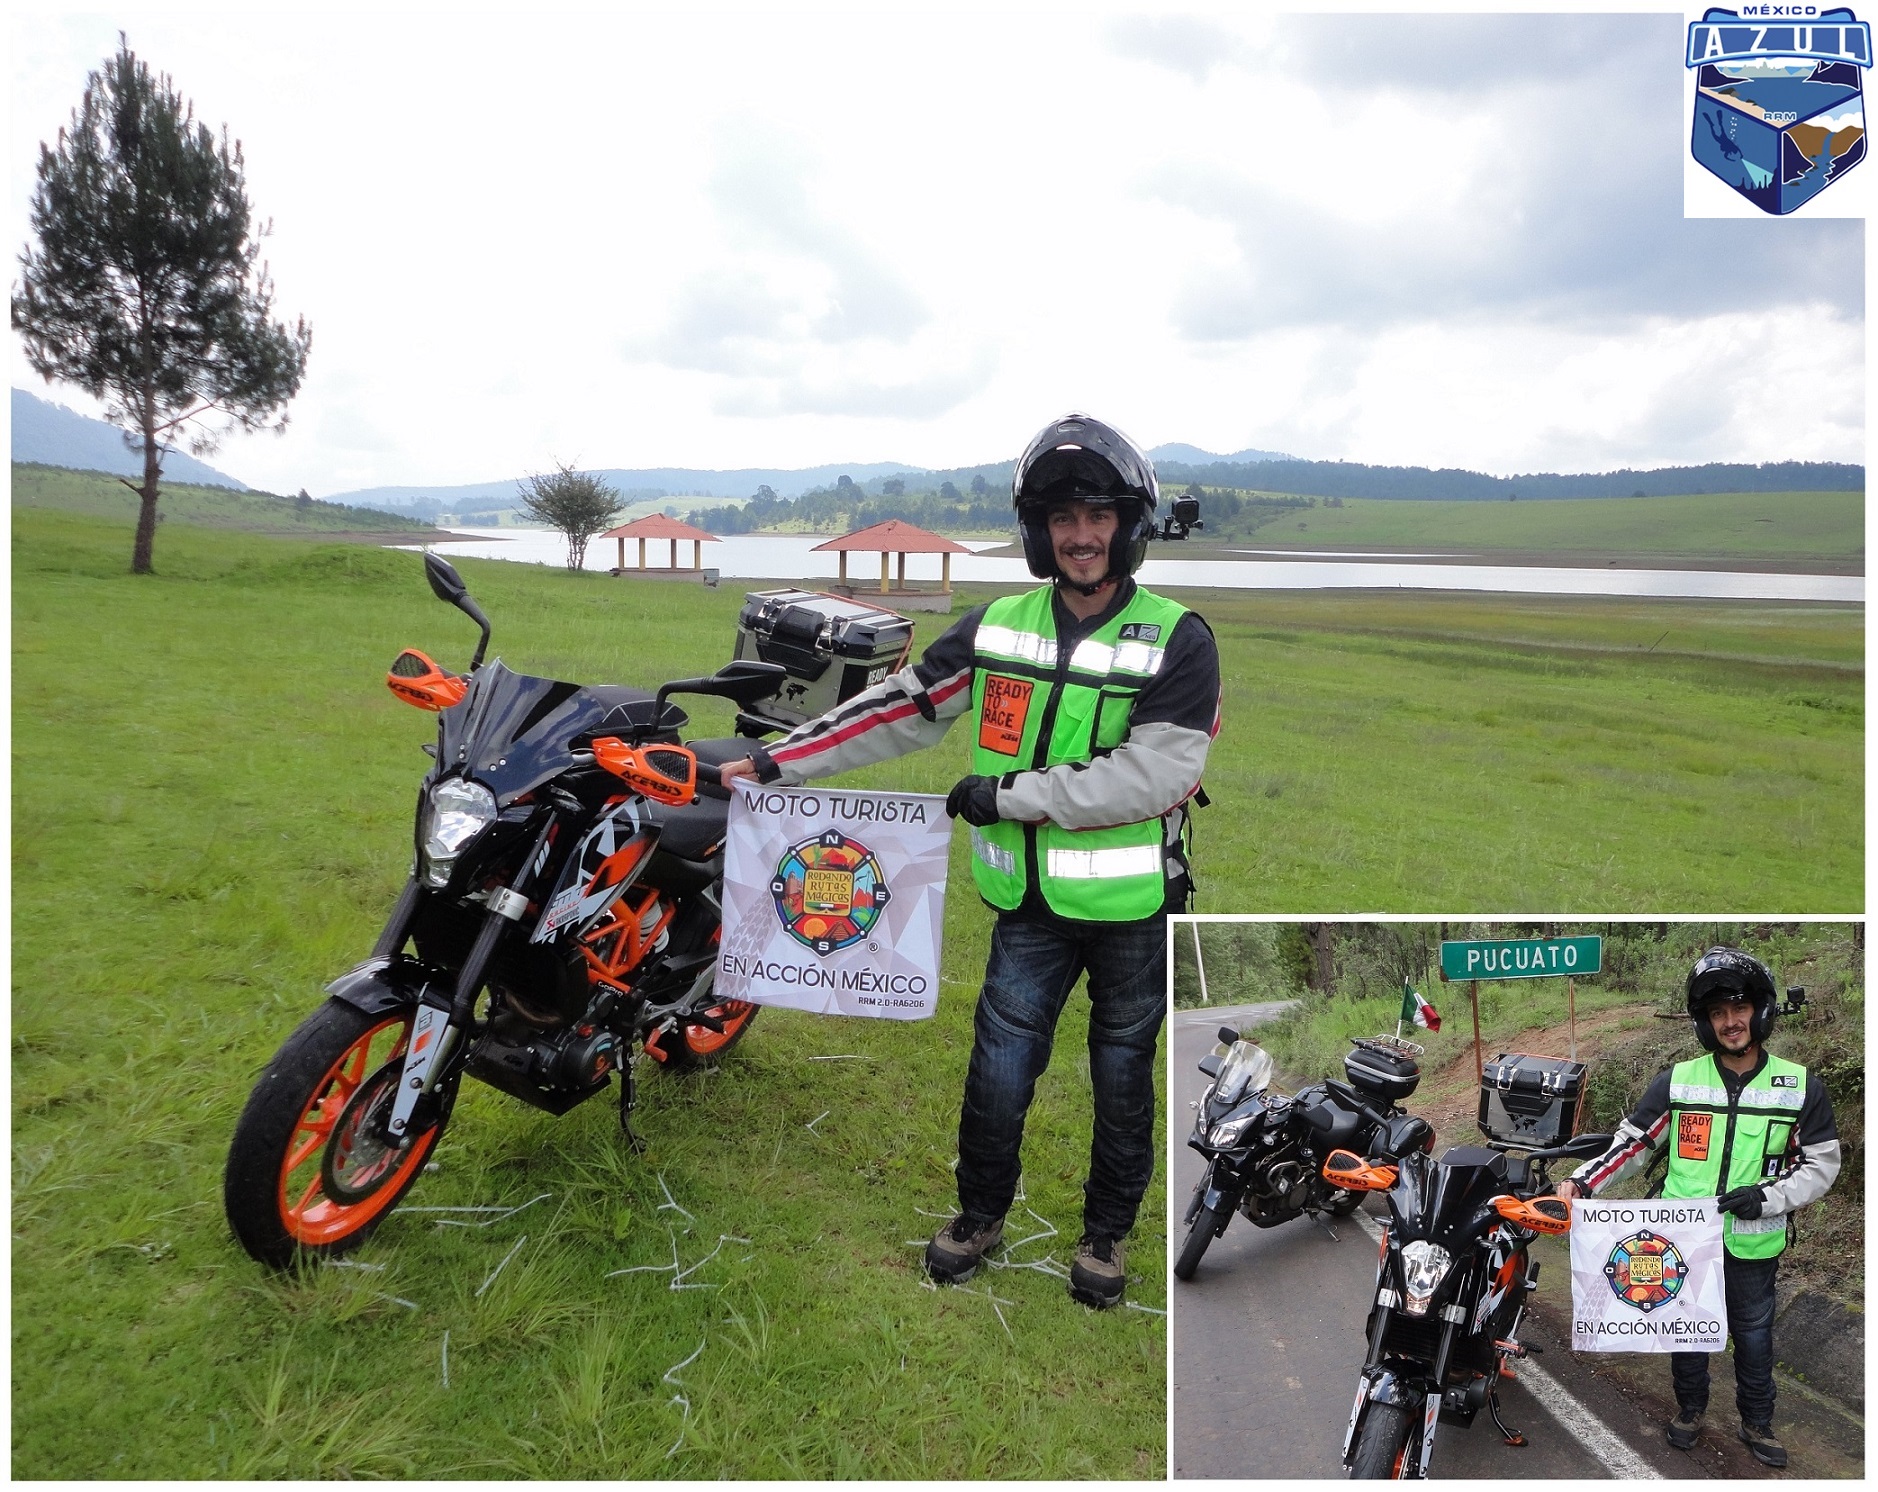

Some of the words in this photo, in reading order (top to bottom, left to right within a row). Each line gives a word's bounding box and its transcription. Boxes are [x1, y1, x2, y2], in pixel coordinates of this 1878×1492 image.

[1122, 625, 1135, 637] A
[866, 666, 889, 684] READY
[987, 679, 1032, 700] READY
[986, 693, 1002, 710] TO
[984, 707, 1015, 728] RACE
[744, 790, 821, 817] MOTO
[828, 796, 927, 825] TURISTA
[826, 835, 839, 844] N
[772, 883, 784, 892] O
[876, 891, 886, 901] E
[818, 941, 829, 951] S
[1467, 945, 1578, 972] PUCUATO
[722, 954, 747, 976] EN
[751, 963, 836, 989] ACCIÓN
[841, 967, 927, 995] MÉXICO
[858, 996, 876, 1006] RRM
[877, 998, 925, 1008] 2.0-RA6206
[1773, 1077, 1784, 1086] A
[1681, 1115, 1711, 1126] READY
[1681, 1125, 1692, 1134] TO
[1680, 1133, 1702, 1144] RACE
[1583, 1208, 1635, 1223] MOTO
[1639, 1208, 1706, 1223] TURISTA
[1576, 1320, 1594, 1334] EN
[1597, 1318, 1657, 1335] ACCIÓN
[1662, 1317, 1721, 1335] MÉXICO
